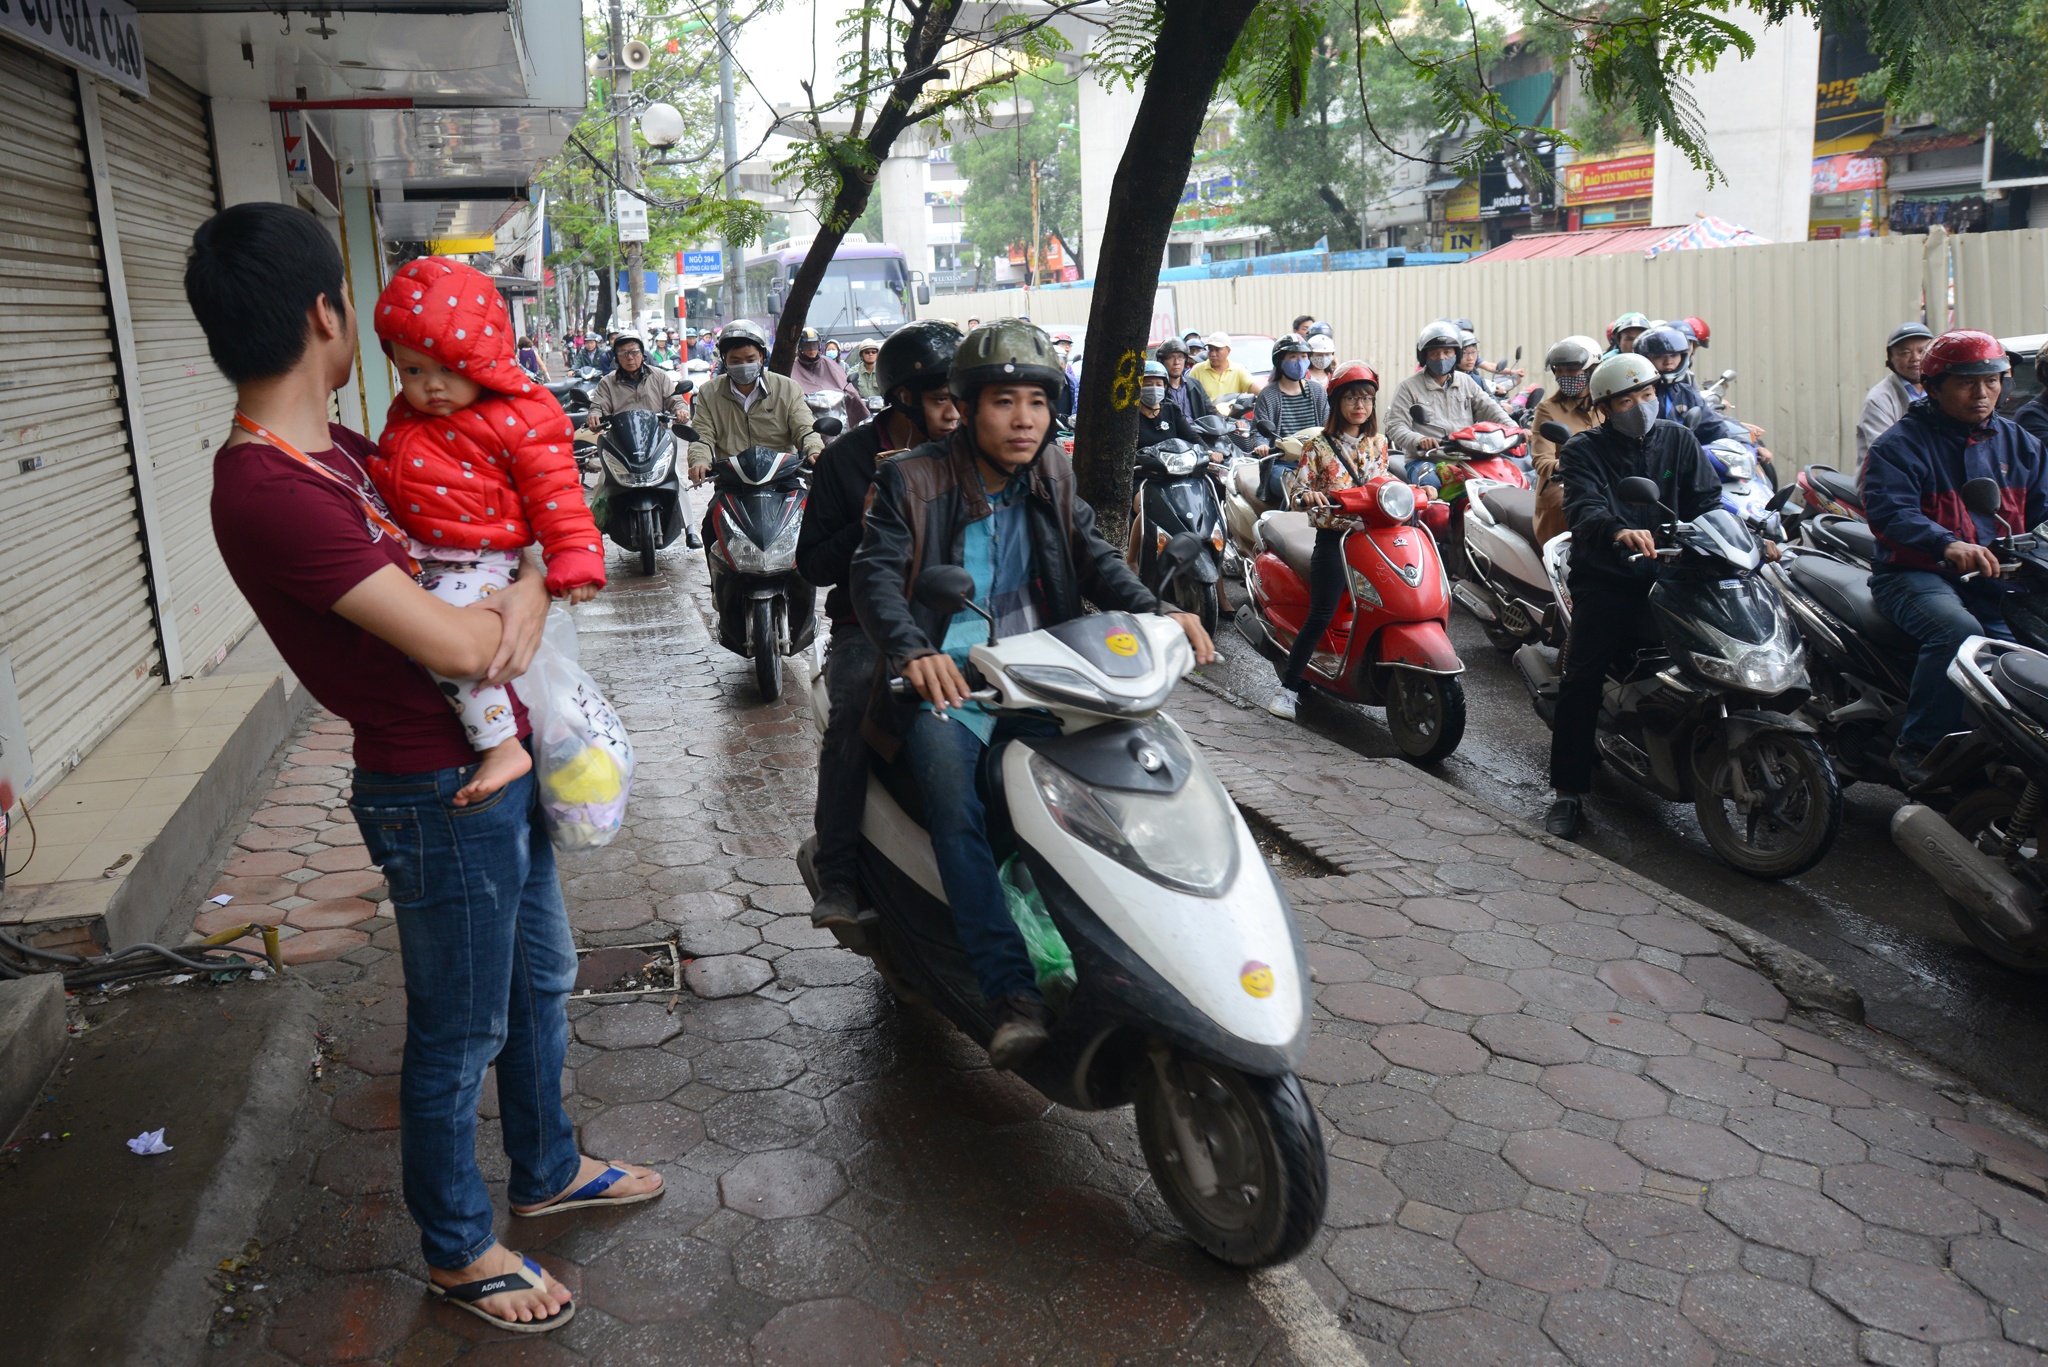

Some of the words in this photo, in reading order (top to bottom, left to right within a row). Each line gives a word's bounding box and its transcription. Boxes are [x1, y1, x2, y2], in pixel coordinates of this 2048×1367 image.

[100, 7, 142, 80] CAO
[1617, 167, 1640, 182] MINH
[1450, 233, 1474, 250] IN
[703, 255, 715, 263] 394
[1360, 602, 1375, 613] SYM
[481, 1280, 507, 1293] ADIVA
